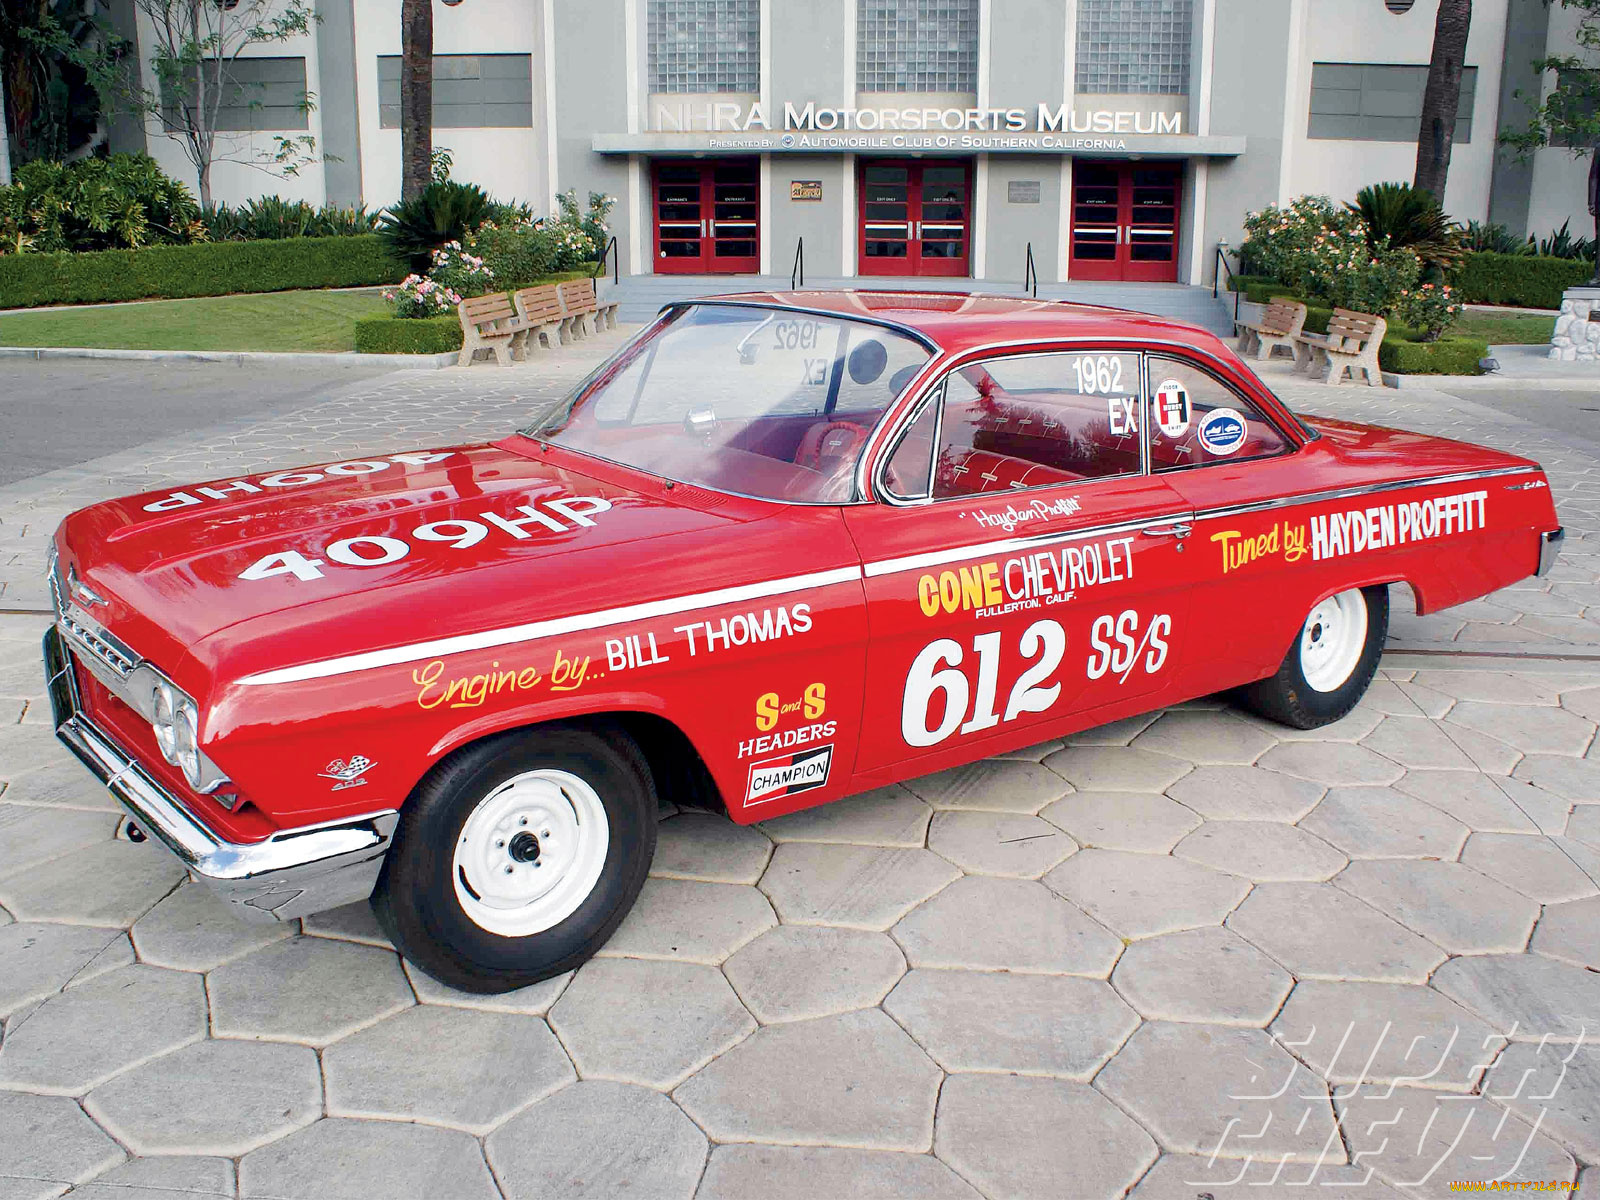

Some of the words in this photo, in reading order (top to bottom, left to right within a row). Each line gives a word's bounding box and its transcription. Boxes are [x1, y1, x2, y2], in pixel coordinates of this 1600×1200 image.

[656, 102, 772, 131] NHRA
[784, 102, 1027, 131] MOTORSPORTS
[1037, 103, 1182, 134] MUSEUM
[799, 135, 888, 147] AUTOMOBILE
[892, 135, 932, 147] CLUB
[935, 136, 957, 147] OF
[961, 136, 1037, 148] SOUTHERN
[1041, 136, 1126, 149] CALIFORNIA
[1072, 356, 1123, 394] 1962
[1107, 397, 1138, 435] EX
[238, 496, 613, 582] 409HP
[1210, 522, 1281, 574] Tuned
[1310, 505, 1397, 561] HAYDEN
[1397, 490, 1488, 544] PROFFITT
[918, 562, 1002, 617] CONE
[1003, 537, 1135, 600] CHEVROLET
[412, 660, 542, 709] Engine
[605, 631, 669, 672] BILL
[674, 603, 813, 657] THOMAS
[1087, 609, 1171, 684] SS/S
[756, 692, 779, 731] S
[780, 697, 802, 714] and
[804, 682, 826, 720] S
[901, 619, 1066, 747] 612
[737, 720, 838, 759] HEADERS
[753, 760, 826, 791] CHAMPION
